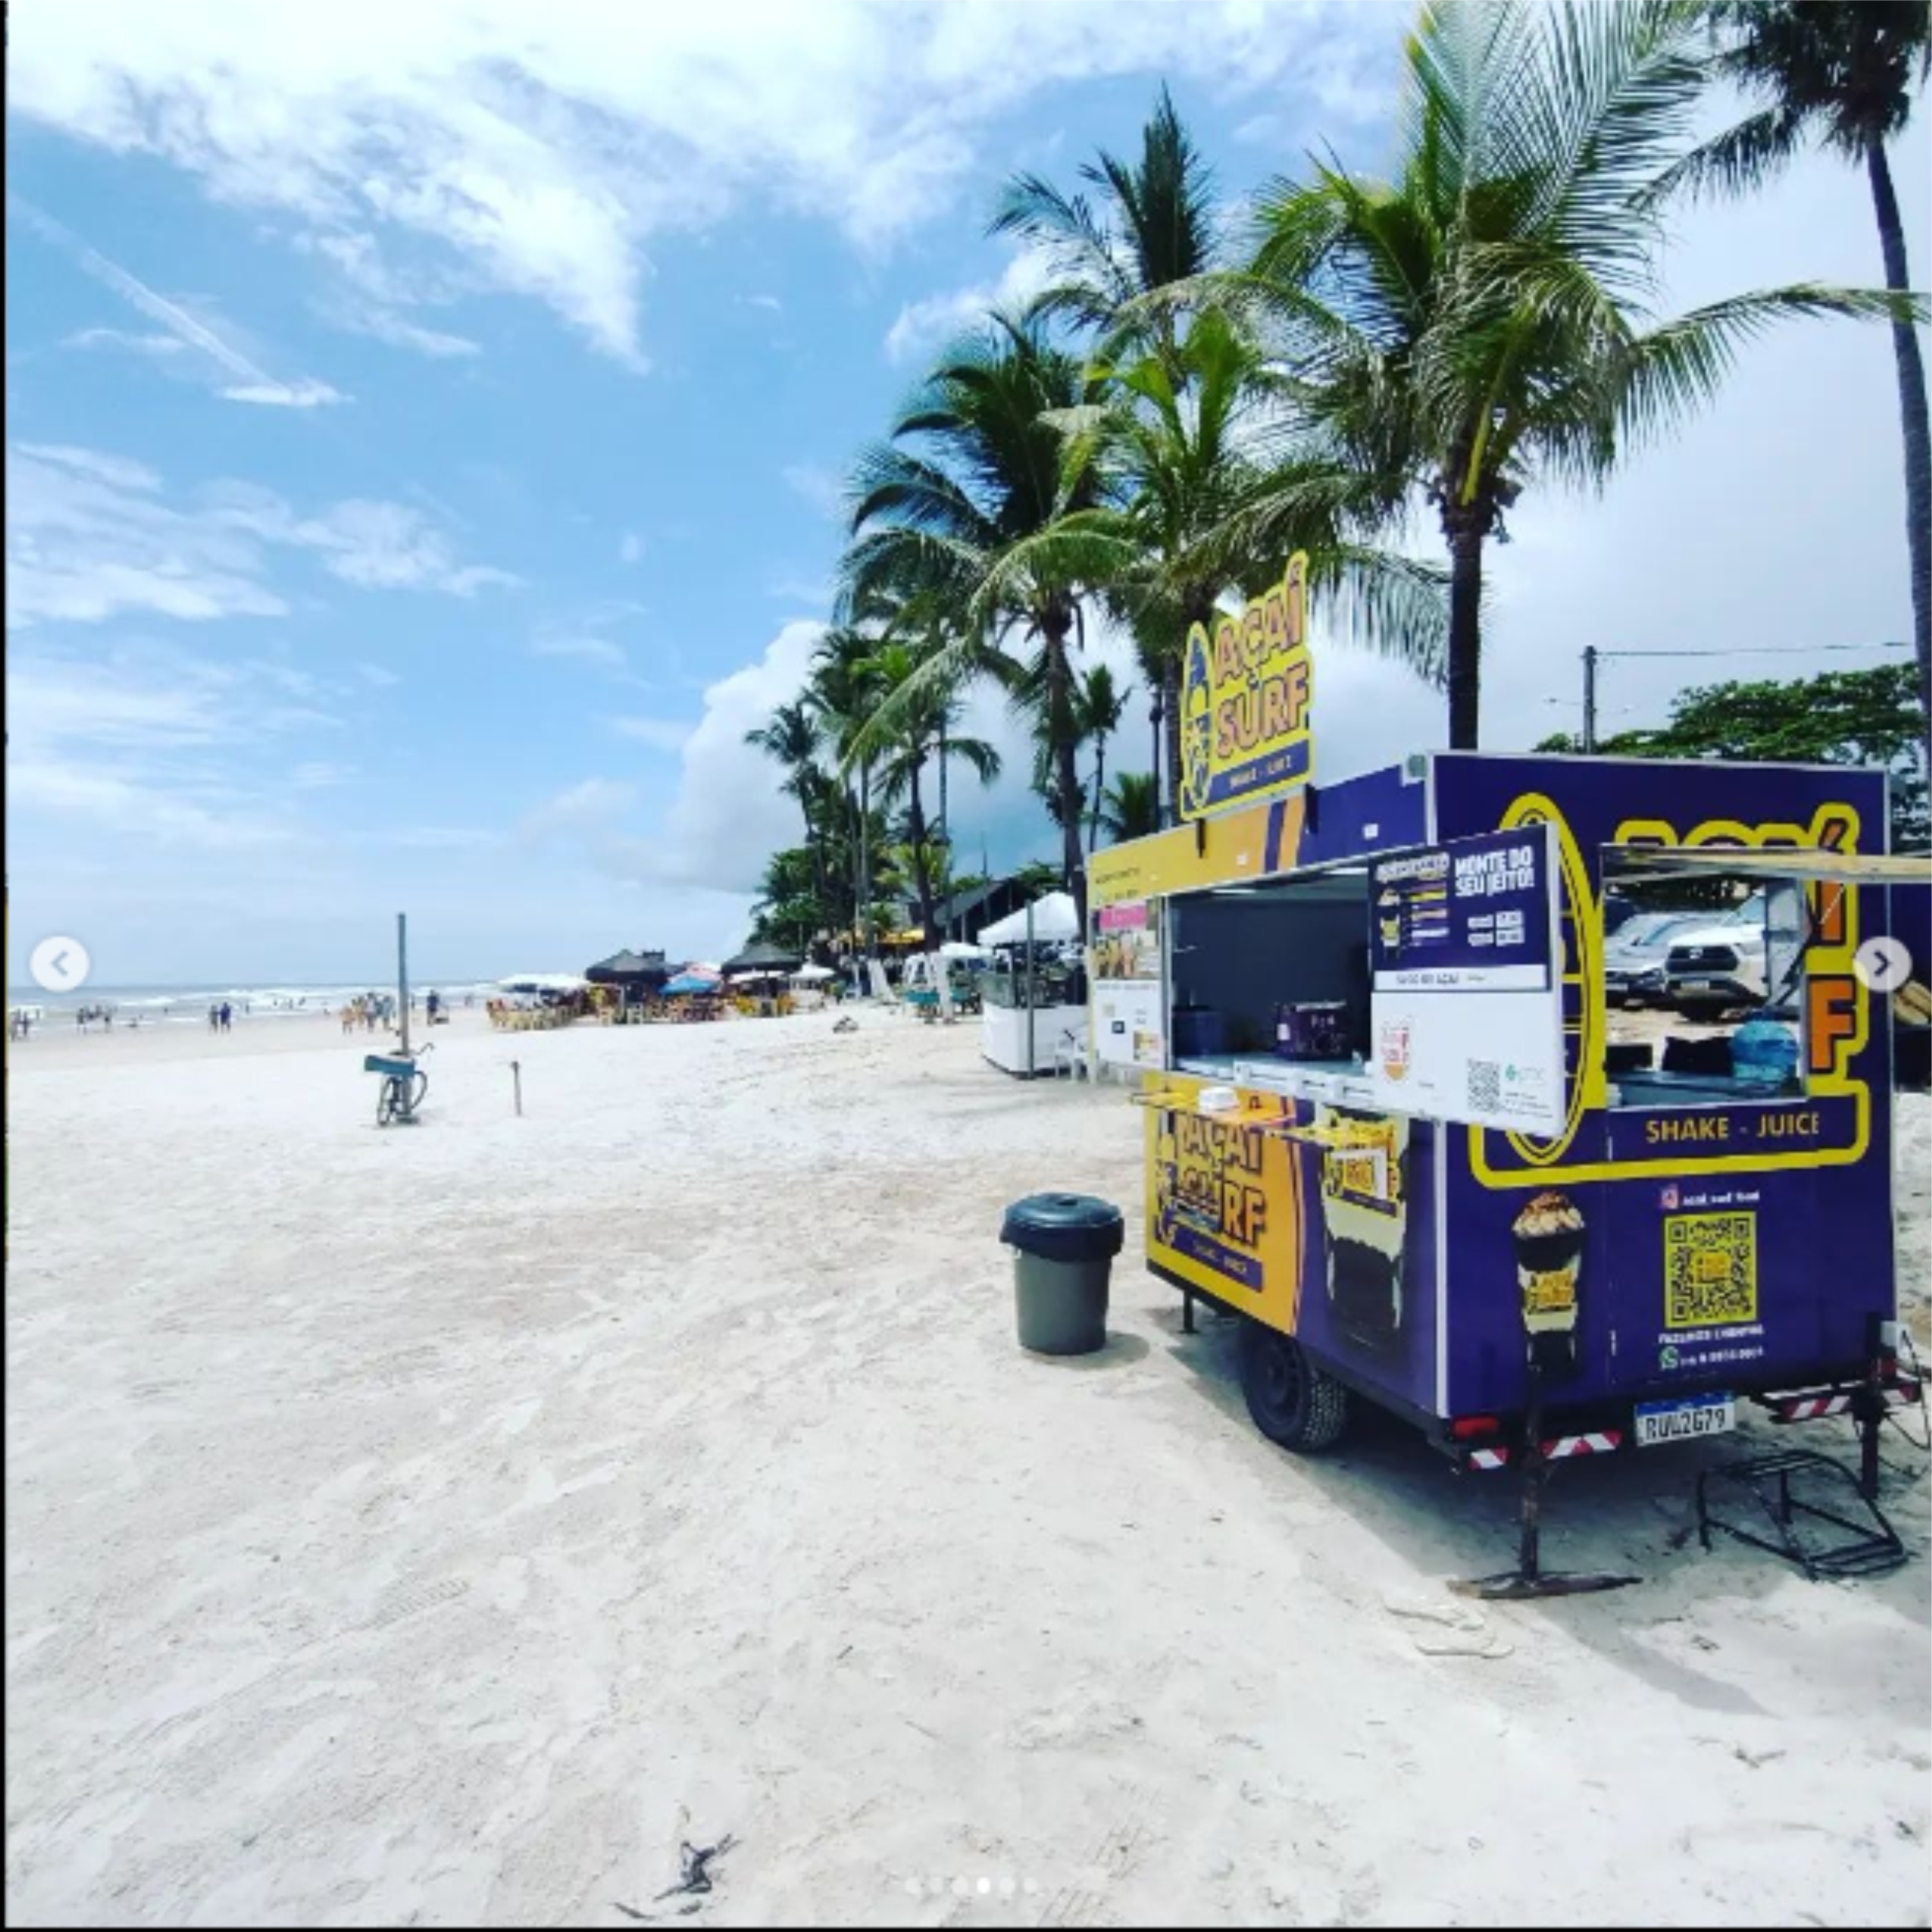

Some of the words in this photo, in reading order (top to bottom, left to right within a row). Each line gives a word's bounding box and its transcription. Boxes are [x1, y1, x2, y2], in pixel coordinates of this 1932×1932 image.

[1215, 560, 1304, 690] AÇAÍ
[1215, 660, 1309, 759] SURF
[1455, 850, 1507, 877] MONTE
[1455, 873, 1485, 897] SEU
[1486, 867, 1534, 897] JEITO!
[1646, 1116, 1729, 1143] SHAKE
[1756, 1111, 1819, 1137] JUICE
